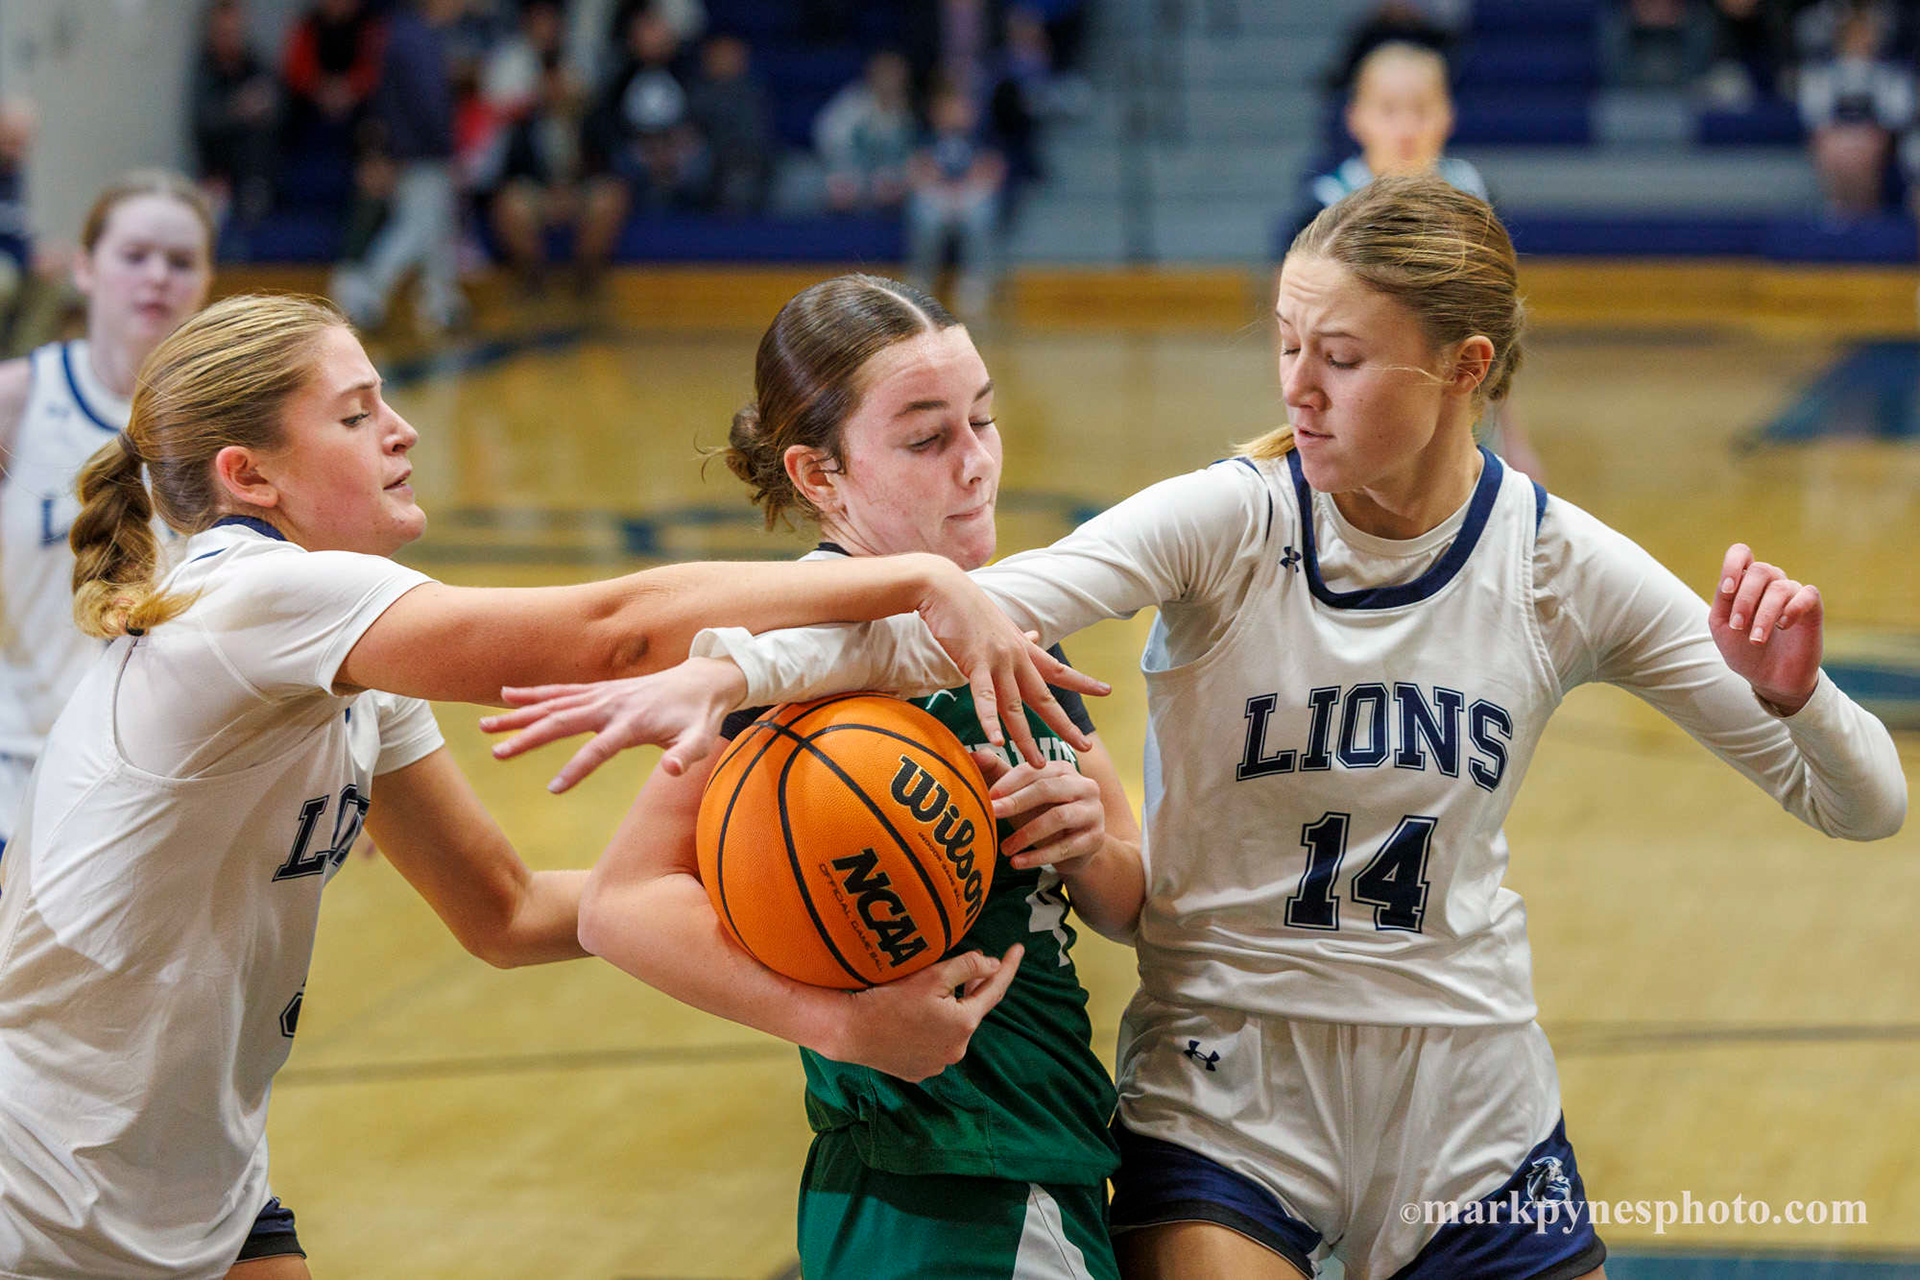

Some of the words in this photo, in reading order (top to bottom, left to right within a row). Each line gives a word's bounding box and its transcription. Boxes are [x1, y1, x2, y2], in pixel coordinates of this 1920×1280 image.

[1236, 681, 1513, 793] LIONS
[890, 753, 984, 931] Wilson
[1284, 811, 1438, 934] 14
[820, 863, 851, 919] OFFICIAL
[850, 920, 874, 951] GAME
[868, 951, 883, 973] BALL
[830, 847, 930, 968] NCAA
